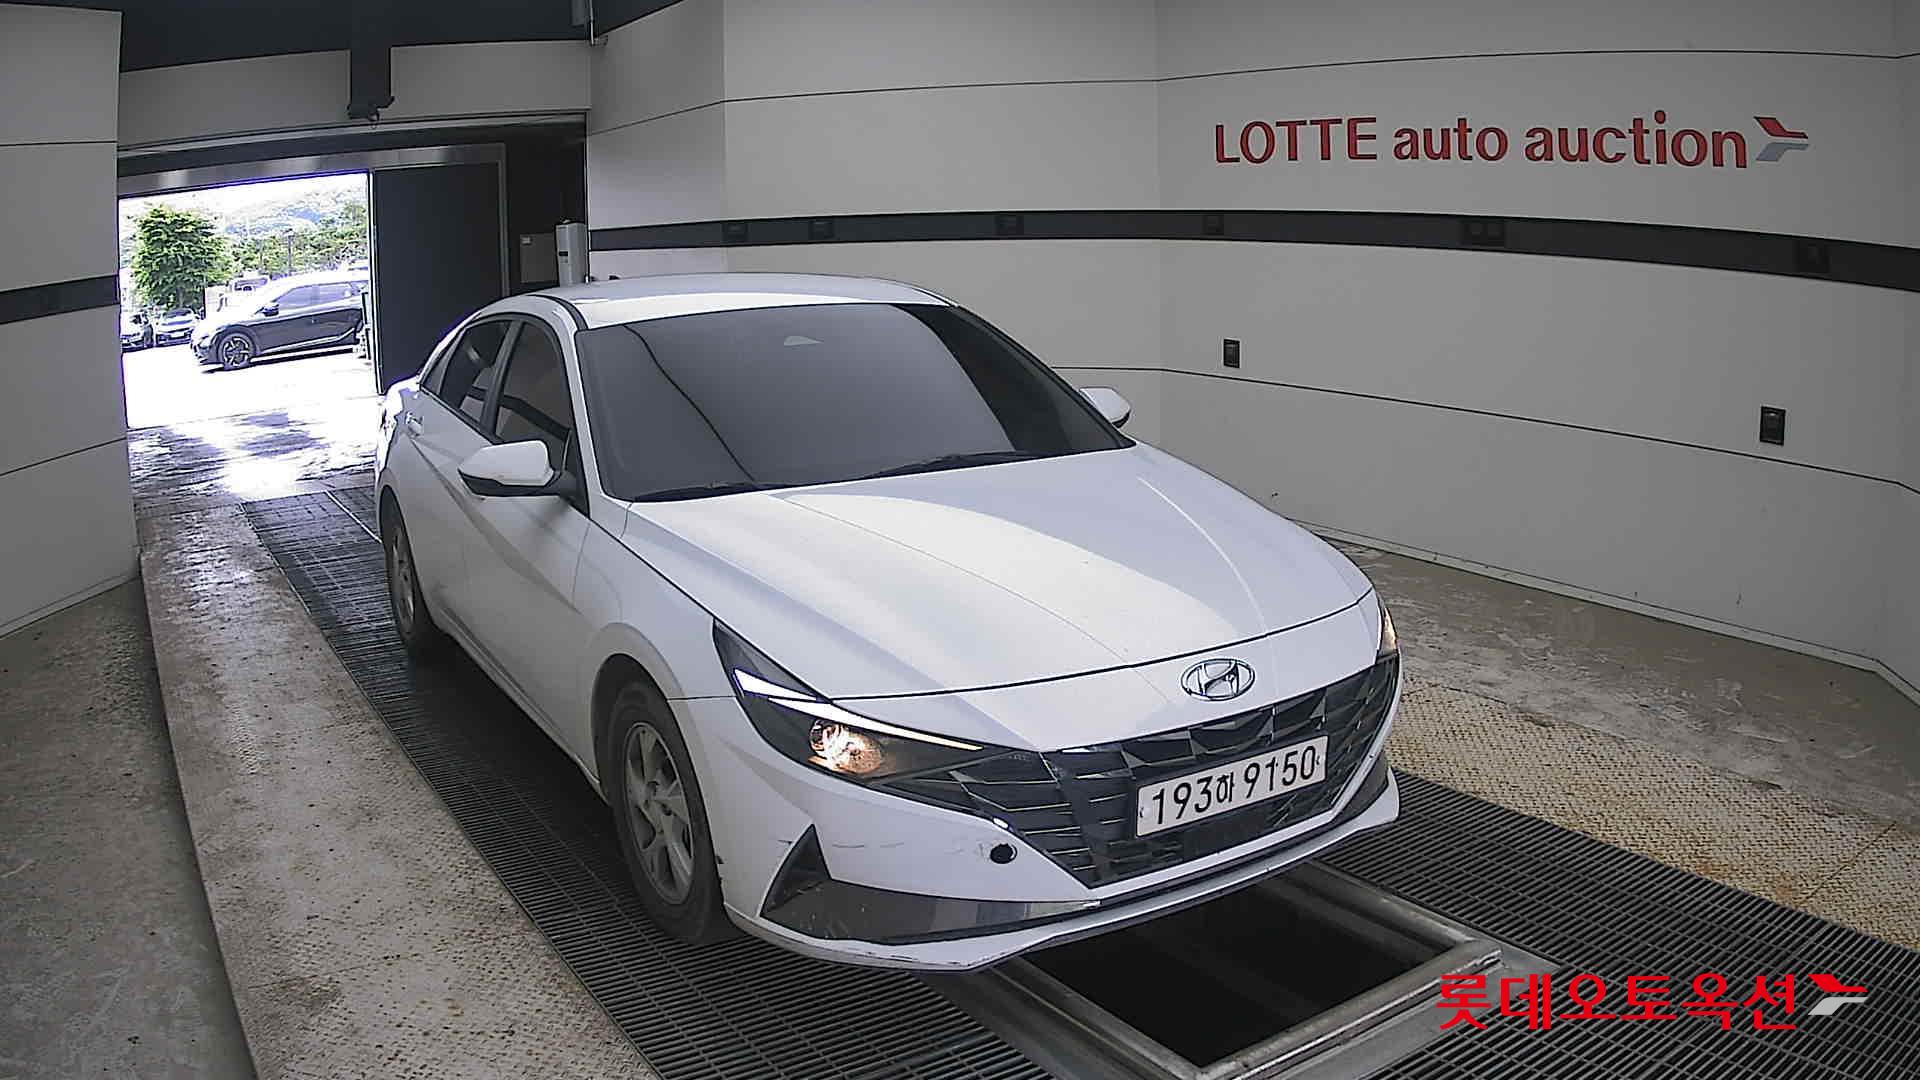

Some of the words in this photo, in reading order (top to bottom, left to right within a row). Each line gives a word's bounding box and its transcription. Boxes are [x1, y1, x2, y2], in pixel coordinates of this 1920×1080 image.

[1214, 116, 1378, 165] LOTTE
[1393, 117, 1509, 163] auto
[1524, 110, 1748, 169] auction
[1152, 771, 1235, 825] 193하
[1243, 745, 1317, 799] 9150
